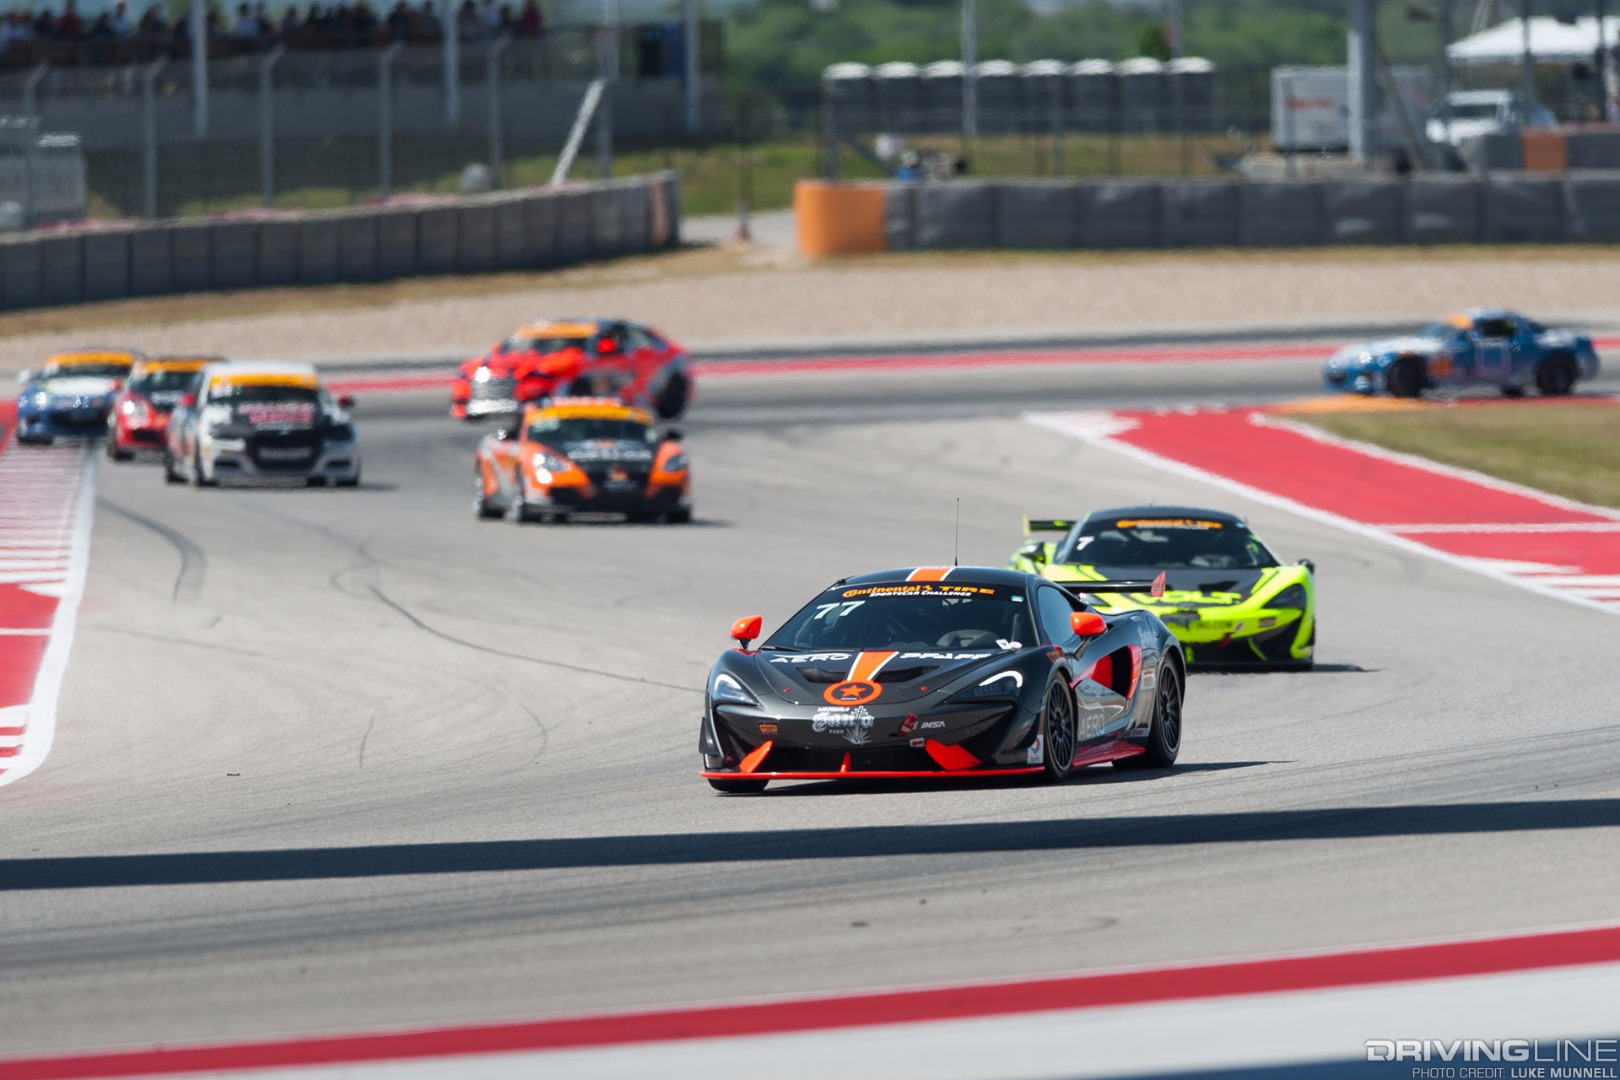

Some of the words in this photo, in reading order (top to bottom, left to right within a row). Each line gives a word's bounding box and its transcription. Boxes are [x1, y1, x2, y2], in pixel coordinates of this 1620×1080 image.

[1075, 535, 1095, 551] 7
[938, 585, 996, 595] TIRE
[814, 600, 866, 620] 77
[769, 654, 850, 663] AERO
[900, 652, 992, 660] PFAFF
[920, 720, 946, 729] IMSA
[1078, 714, 1106, 741] AERO
